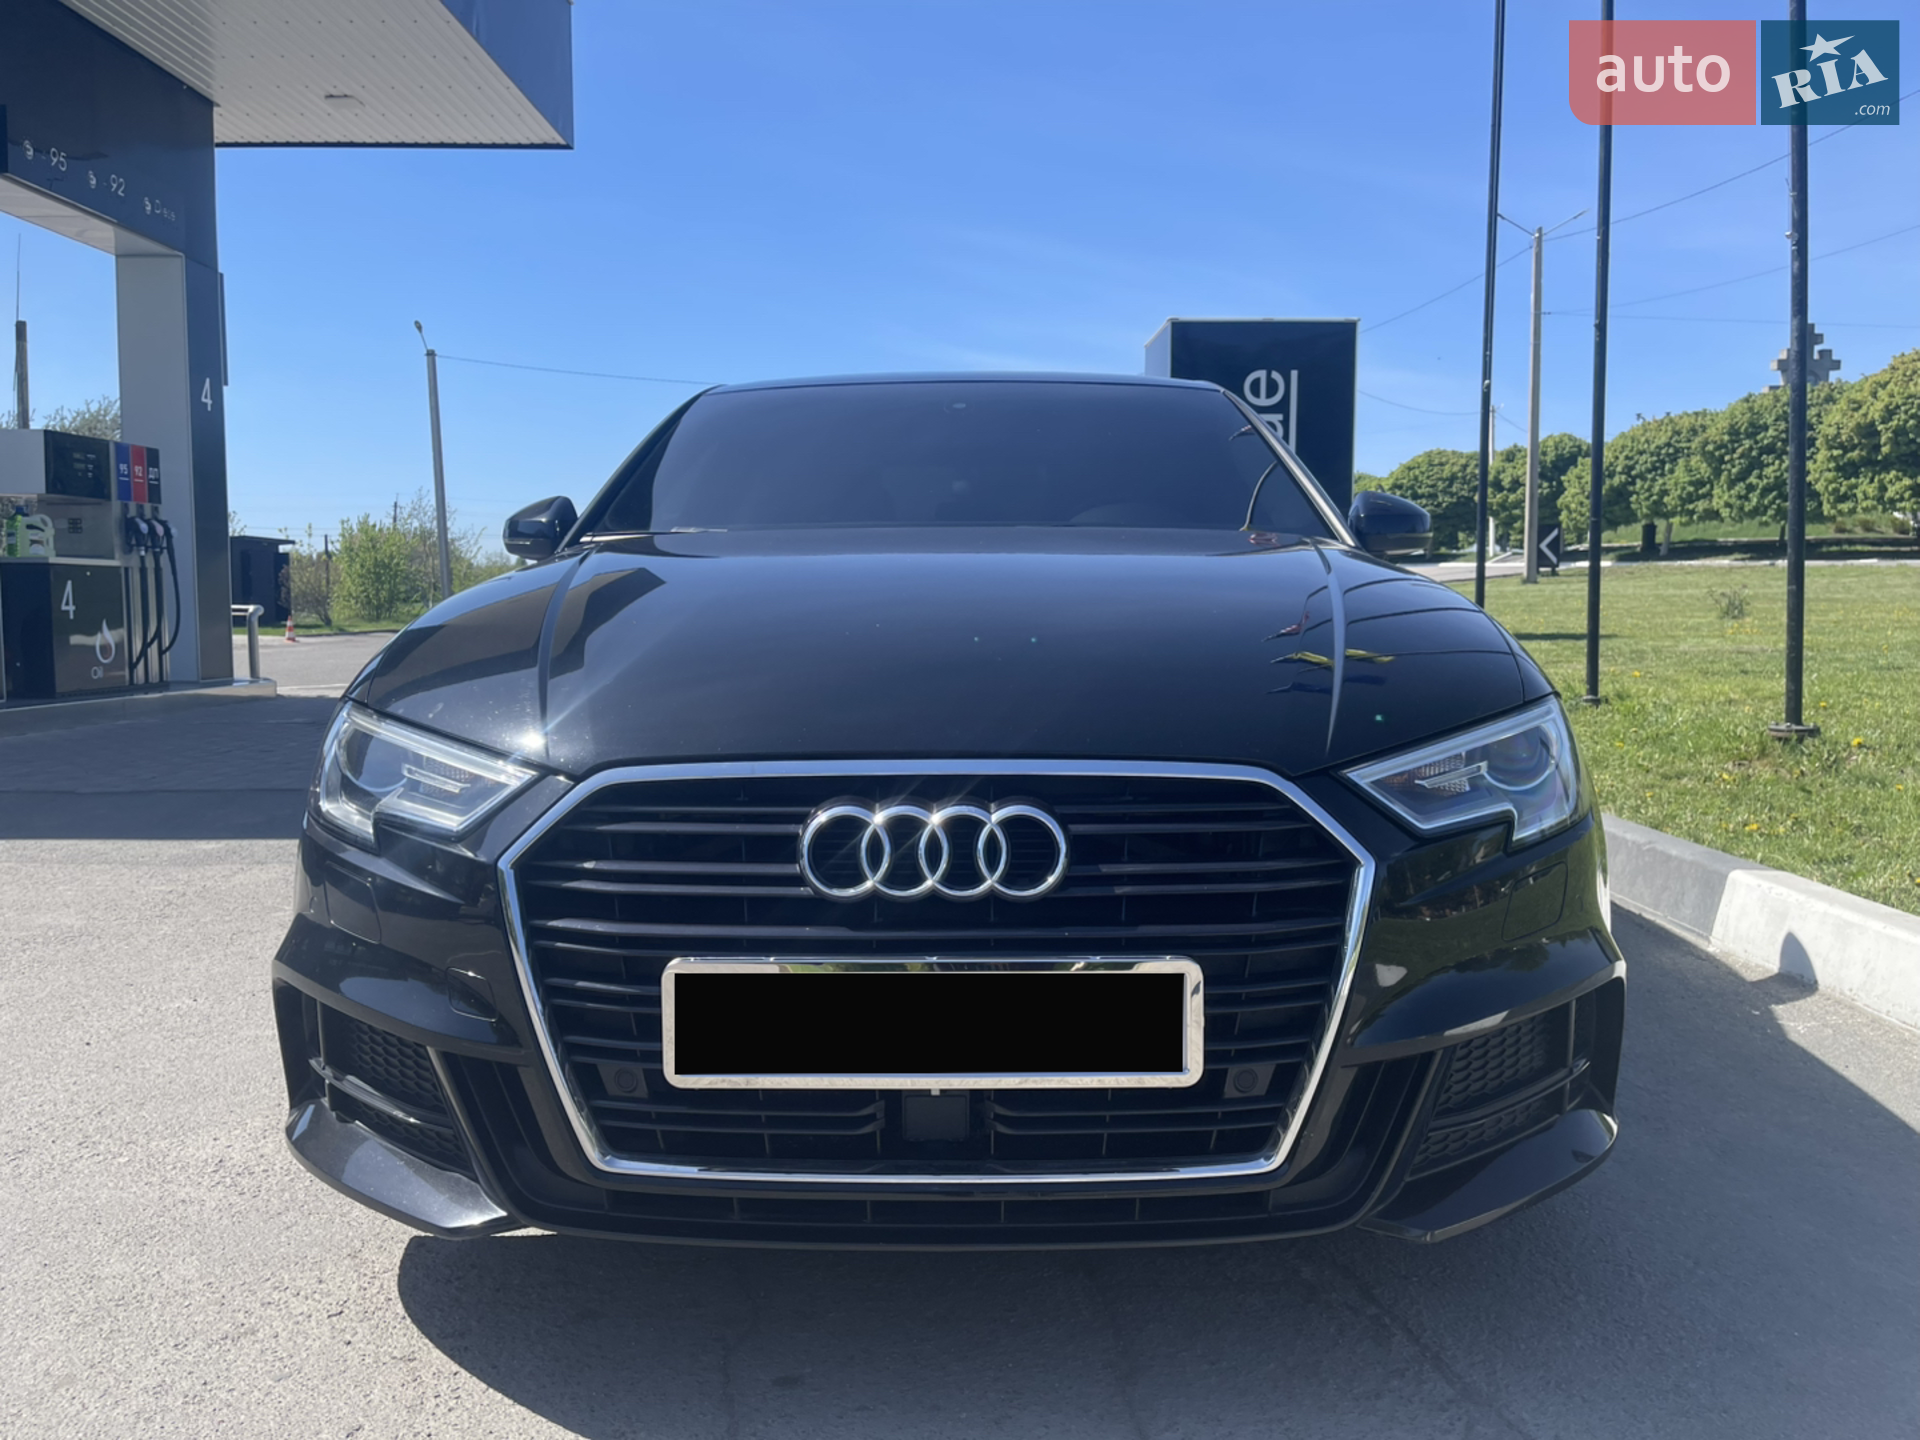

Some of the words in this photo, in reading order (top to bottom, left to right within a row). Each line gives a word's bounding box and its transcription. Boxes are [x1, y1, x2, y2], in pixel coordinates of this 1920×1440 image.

[50, 147, 69, 171] 95
[110, 174, 125, 197] 92
[201, 377, 213, 411] 4
[119, 463, 129, 475] 95
[134, 465, 143, 477] 92
[61, 580, 76, 619] 4
